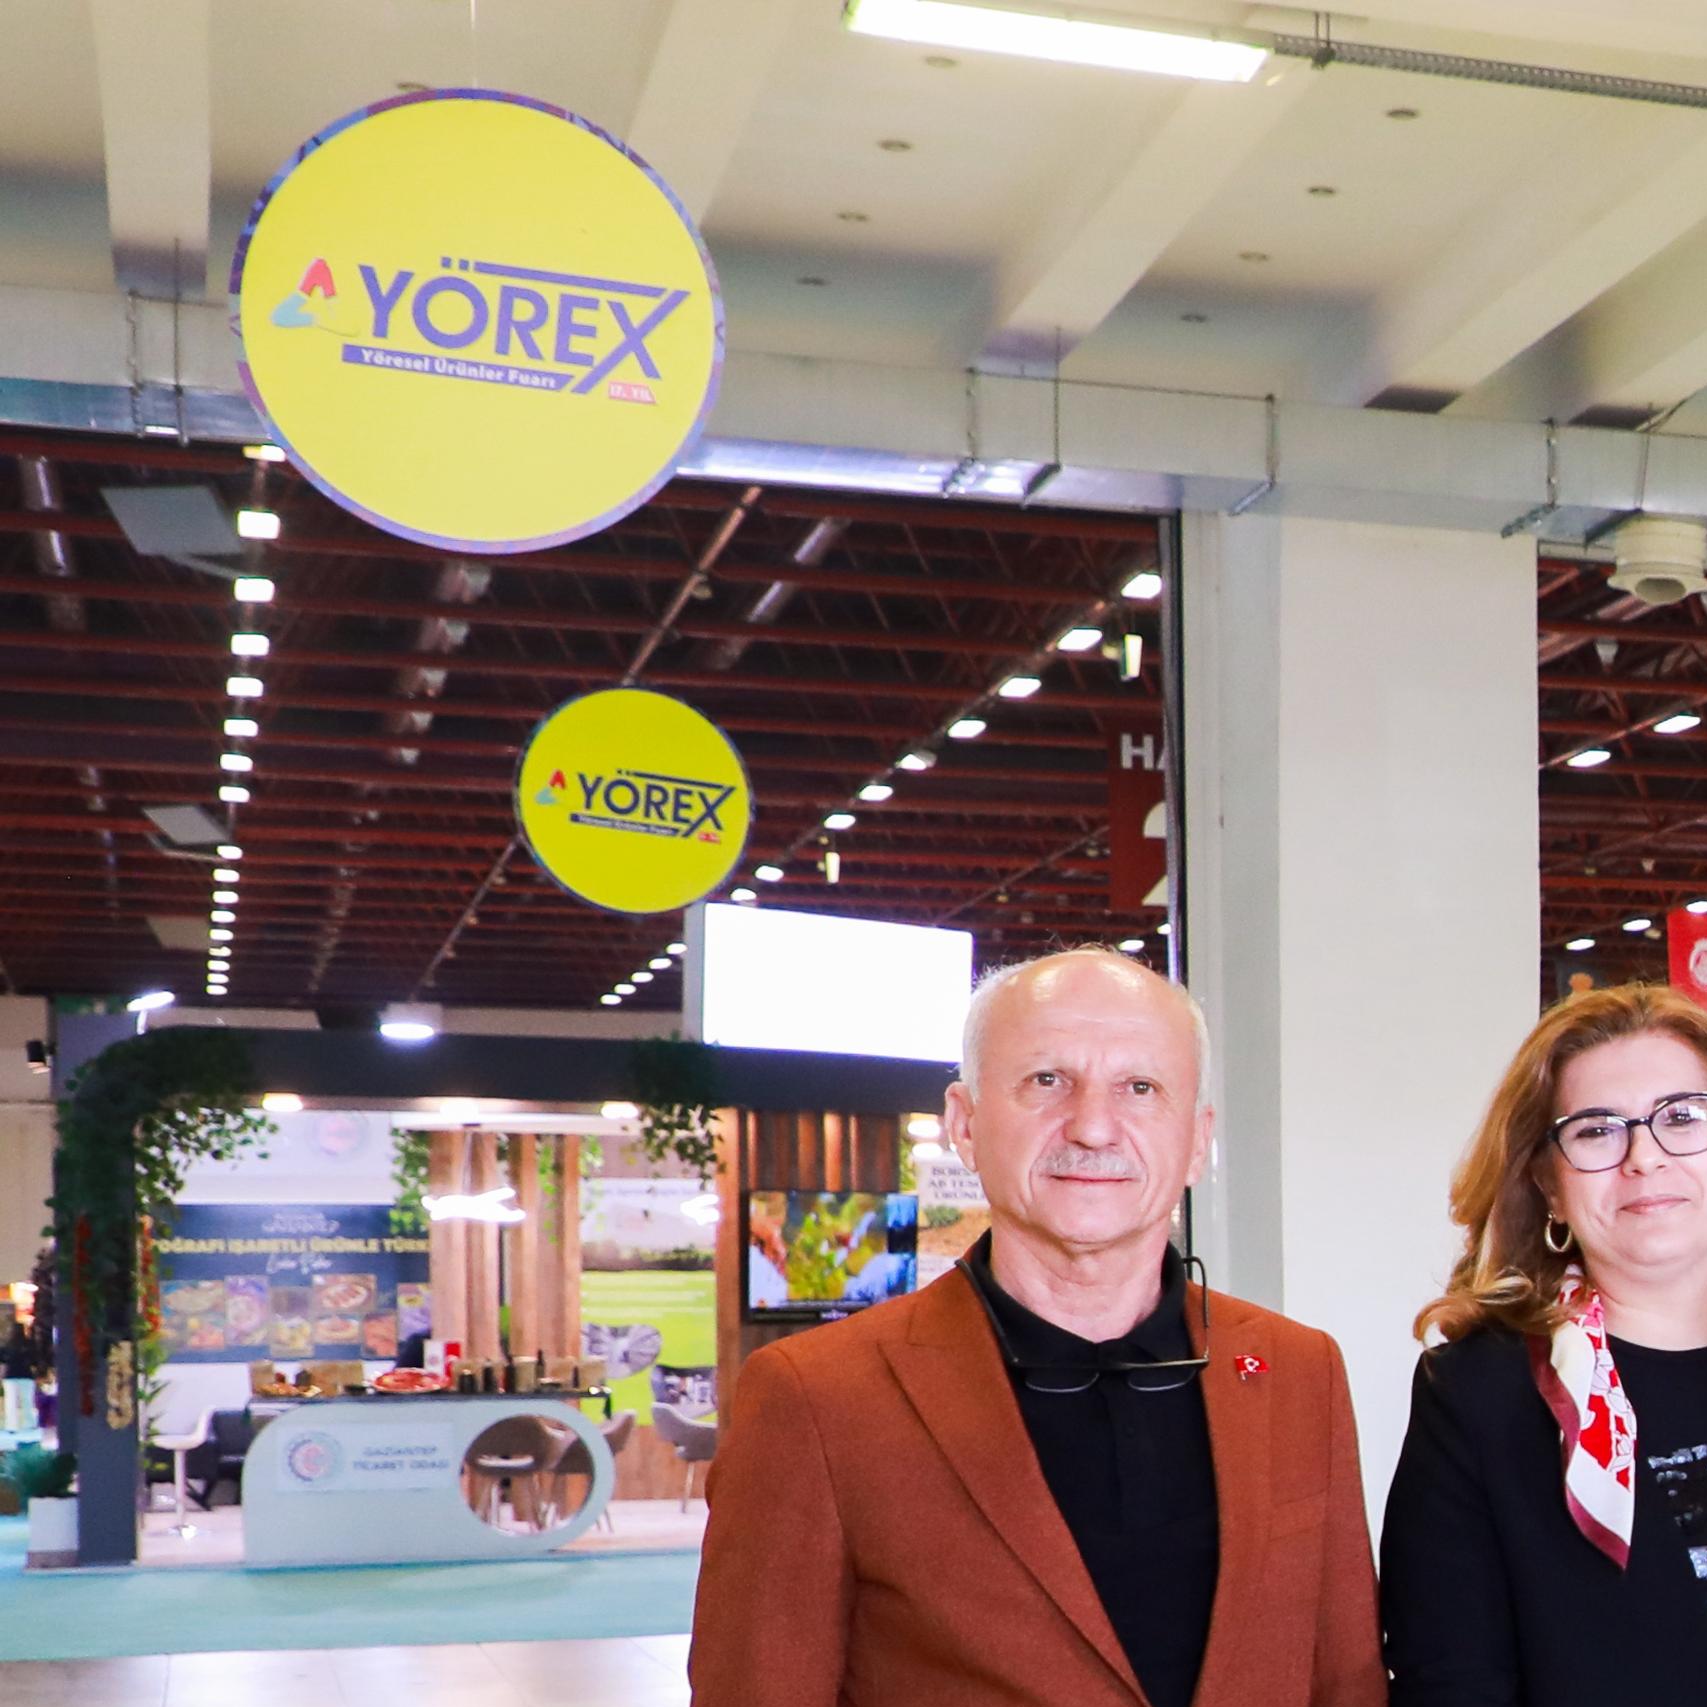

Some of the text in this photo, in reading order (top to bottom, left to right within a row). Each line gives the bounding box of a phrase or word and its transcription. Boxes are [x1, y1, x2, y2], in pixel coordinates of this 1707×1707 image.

[357, 256, 690, 394] YÖREX
[361, 349, 557, 388] Yöresel Ürünler Fuarı
[1120, 733, 1166, 770] H
[577, 769, 736, 838] YÖREX
